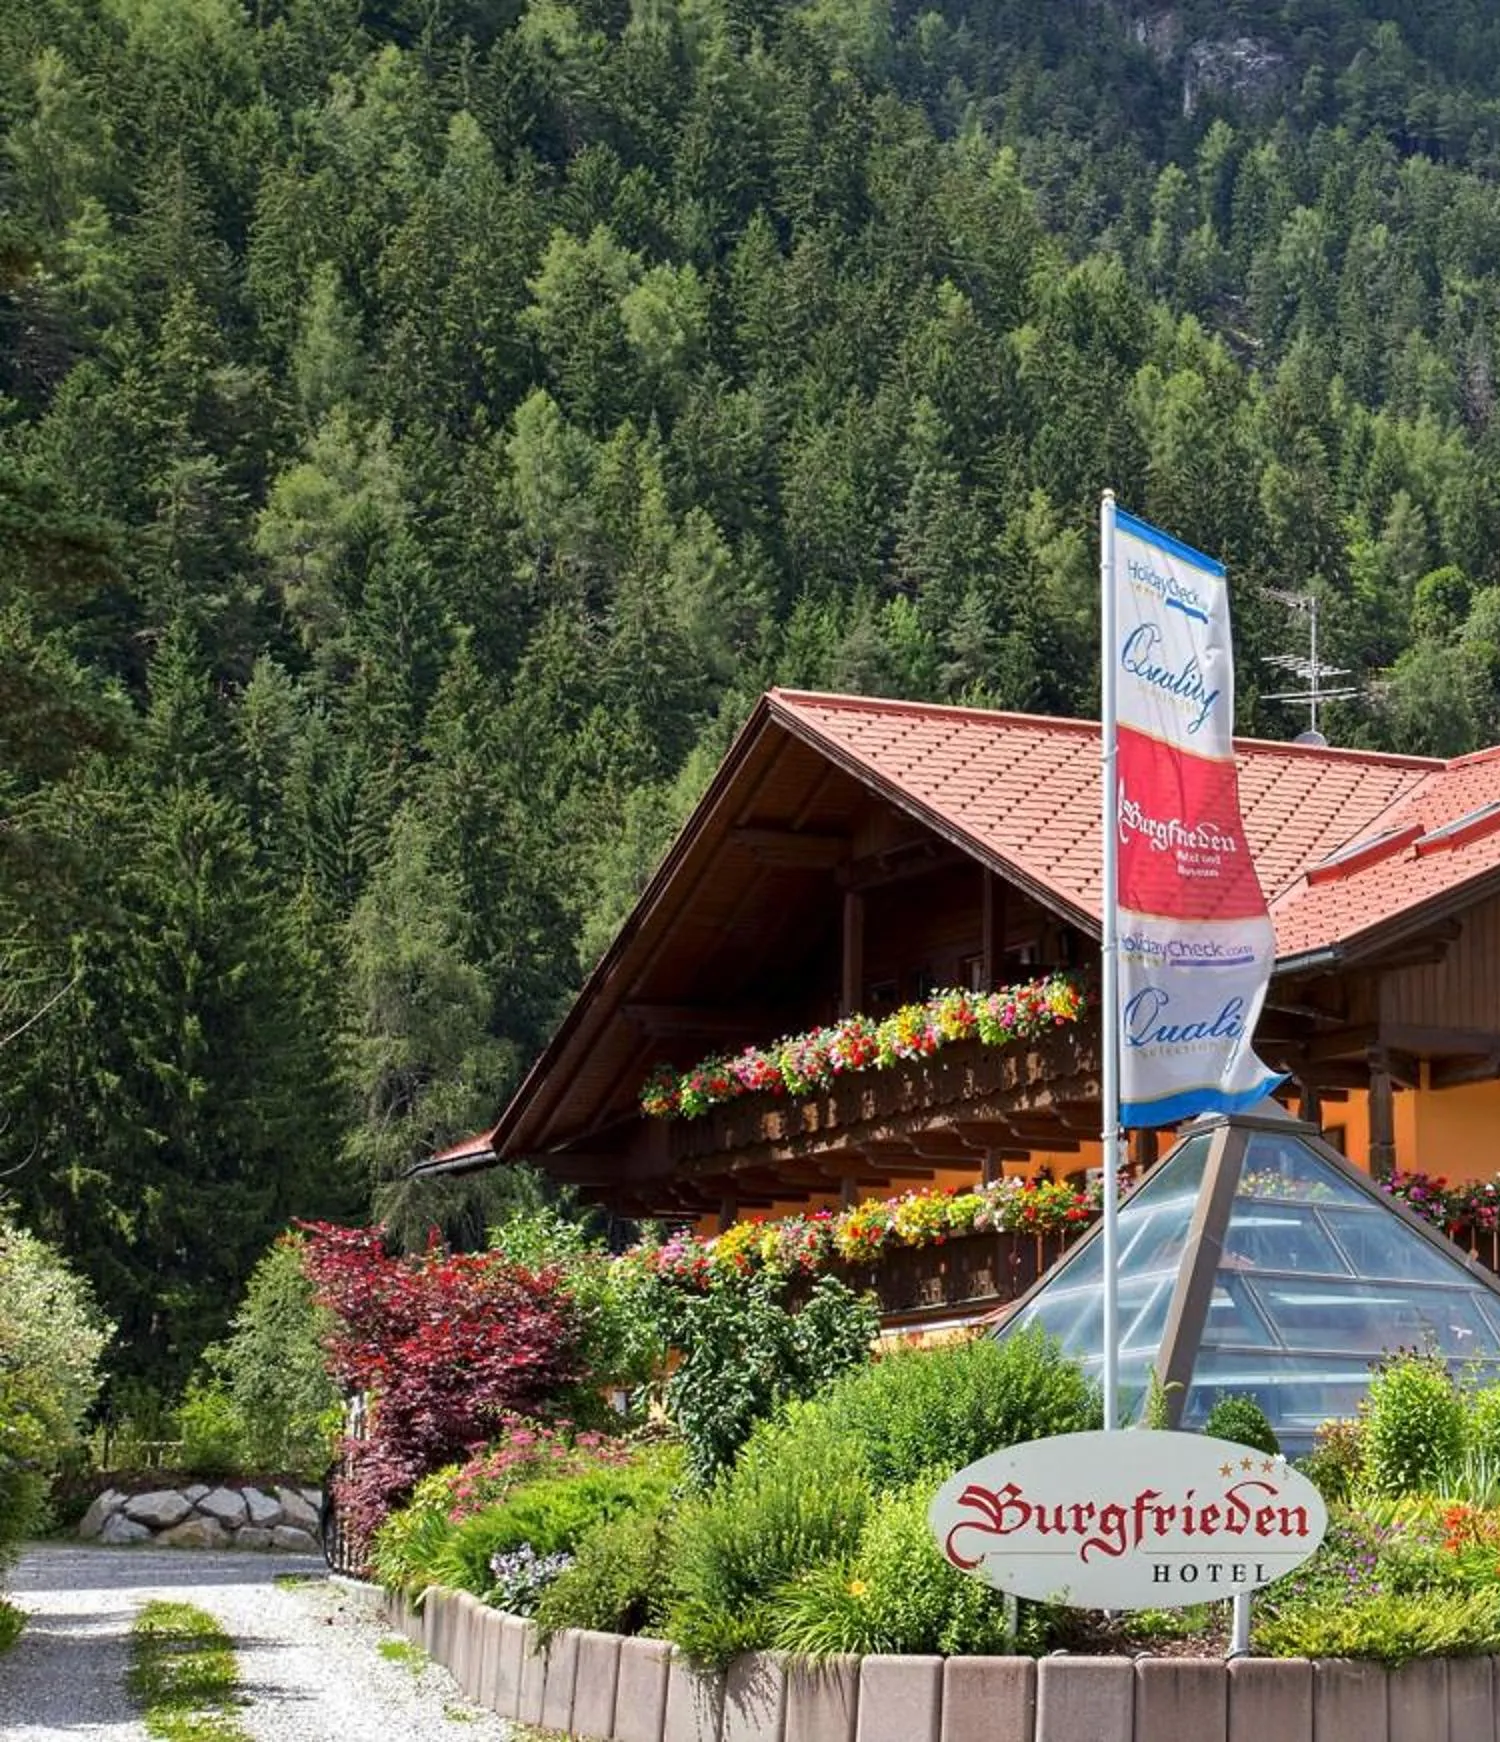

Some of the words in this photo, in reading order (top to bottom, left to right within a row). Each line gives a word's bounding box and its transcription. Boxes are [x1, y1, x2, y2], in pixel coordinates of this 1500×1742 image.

[1121, 623, 1221, 735] Quality
[1118, 777, 1237, 852] Burgfrieden
[1121, 931, 1253, 960] olidayCheck.com
[1124, 986, 1246, 1072] Quali
[945, 1481, 1309, 1570] Burgfrieden
[1152, 1563, 1270, 1583] HOTEL
